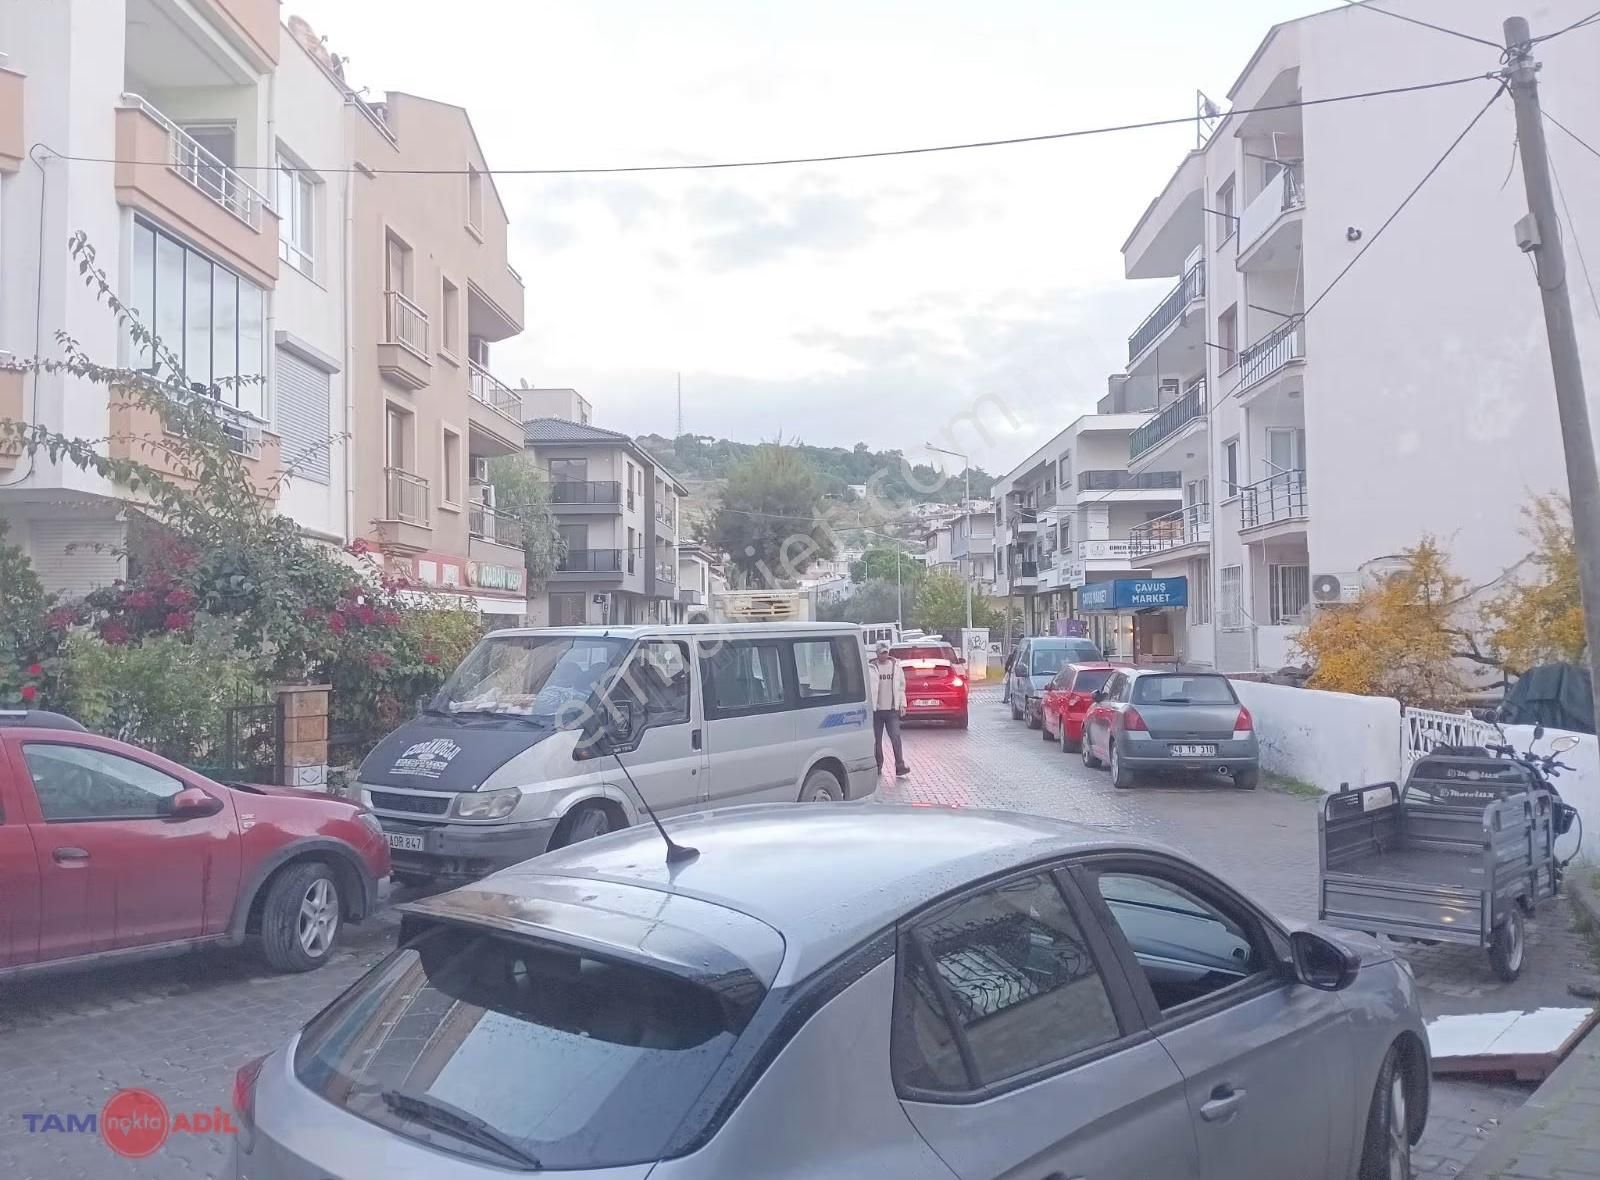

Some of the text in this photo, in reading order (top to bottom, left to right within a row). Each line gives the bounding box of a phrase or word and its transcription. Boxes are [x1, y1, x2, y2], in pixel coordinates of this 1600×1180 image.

[1135, 583, 1166, 593] ÇAVUŞ
[1132, 594, 1170, 603] MARKET
[405, 837, 421, 849] 847
